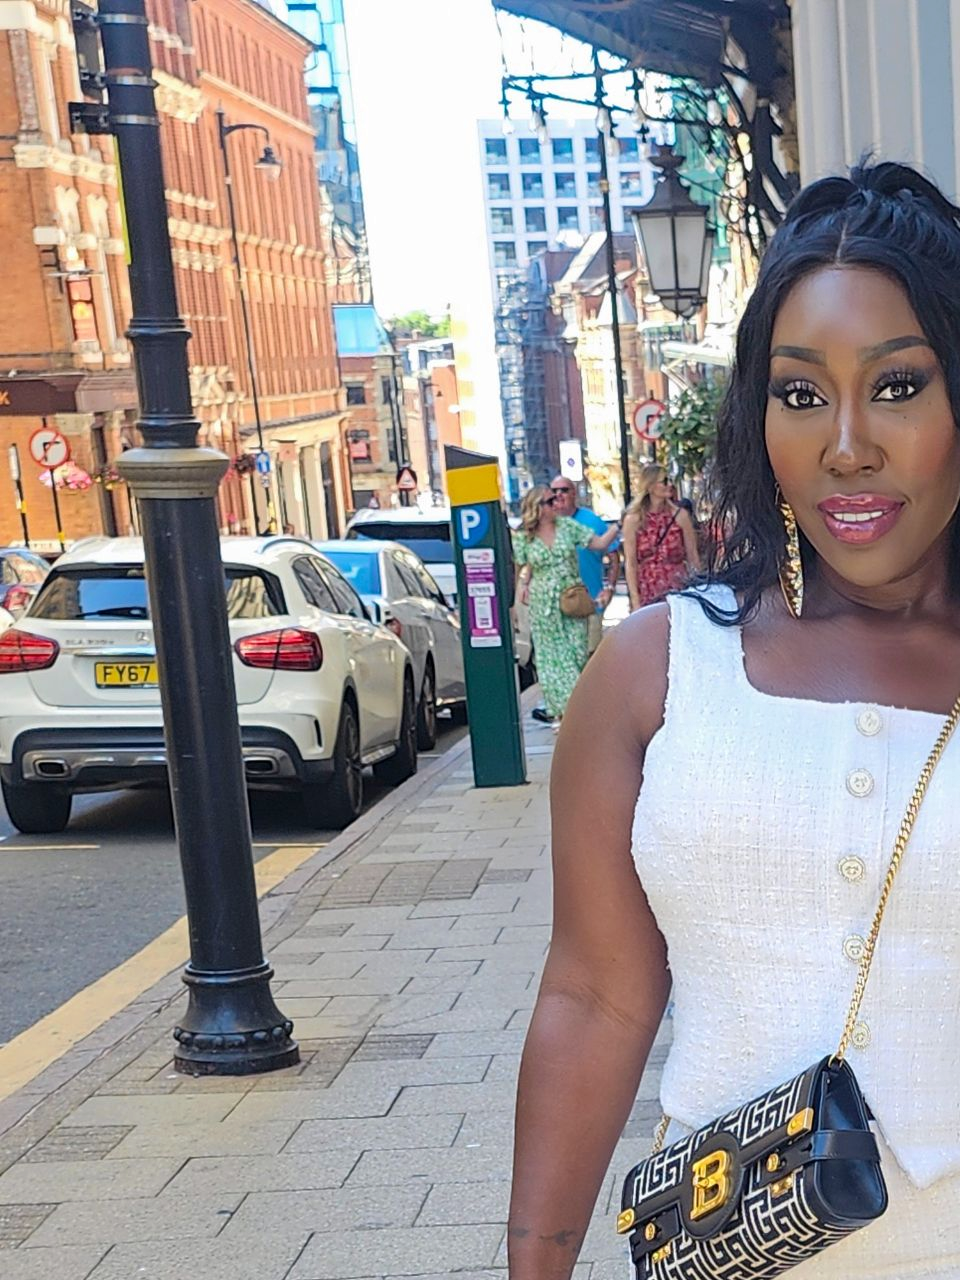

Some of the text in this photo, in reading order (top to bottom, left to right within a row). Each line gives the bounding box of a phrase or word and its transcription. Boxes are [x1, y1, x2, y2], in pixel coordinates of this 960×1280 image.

[461, 509, 481, 540] P
[103, 665, 150, 682] FY67
[689, 1149, 728, 1221] B
